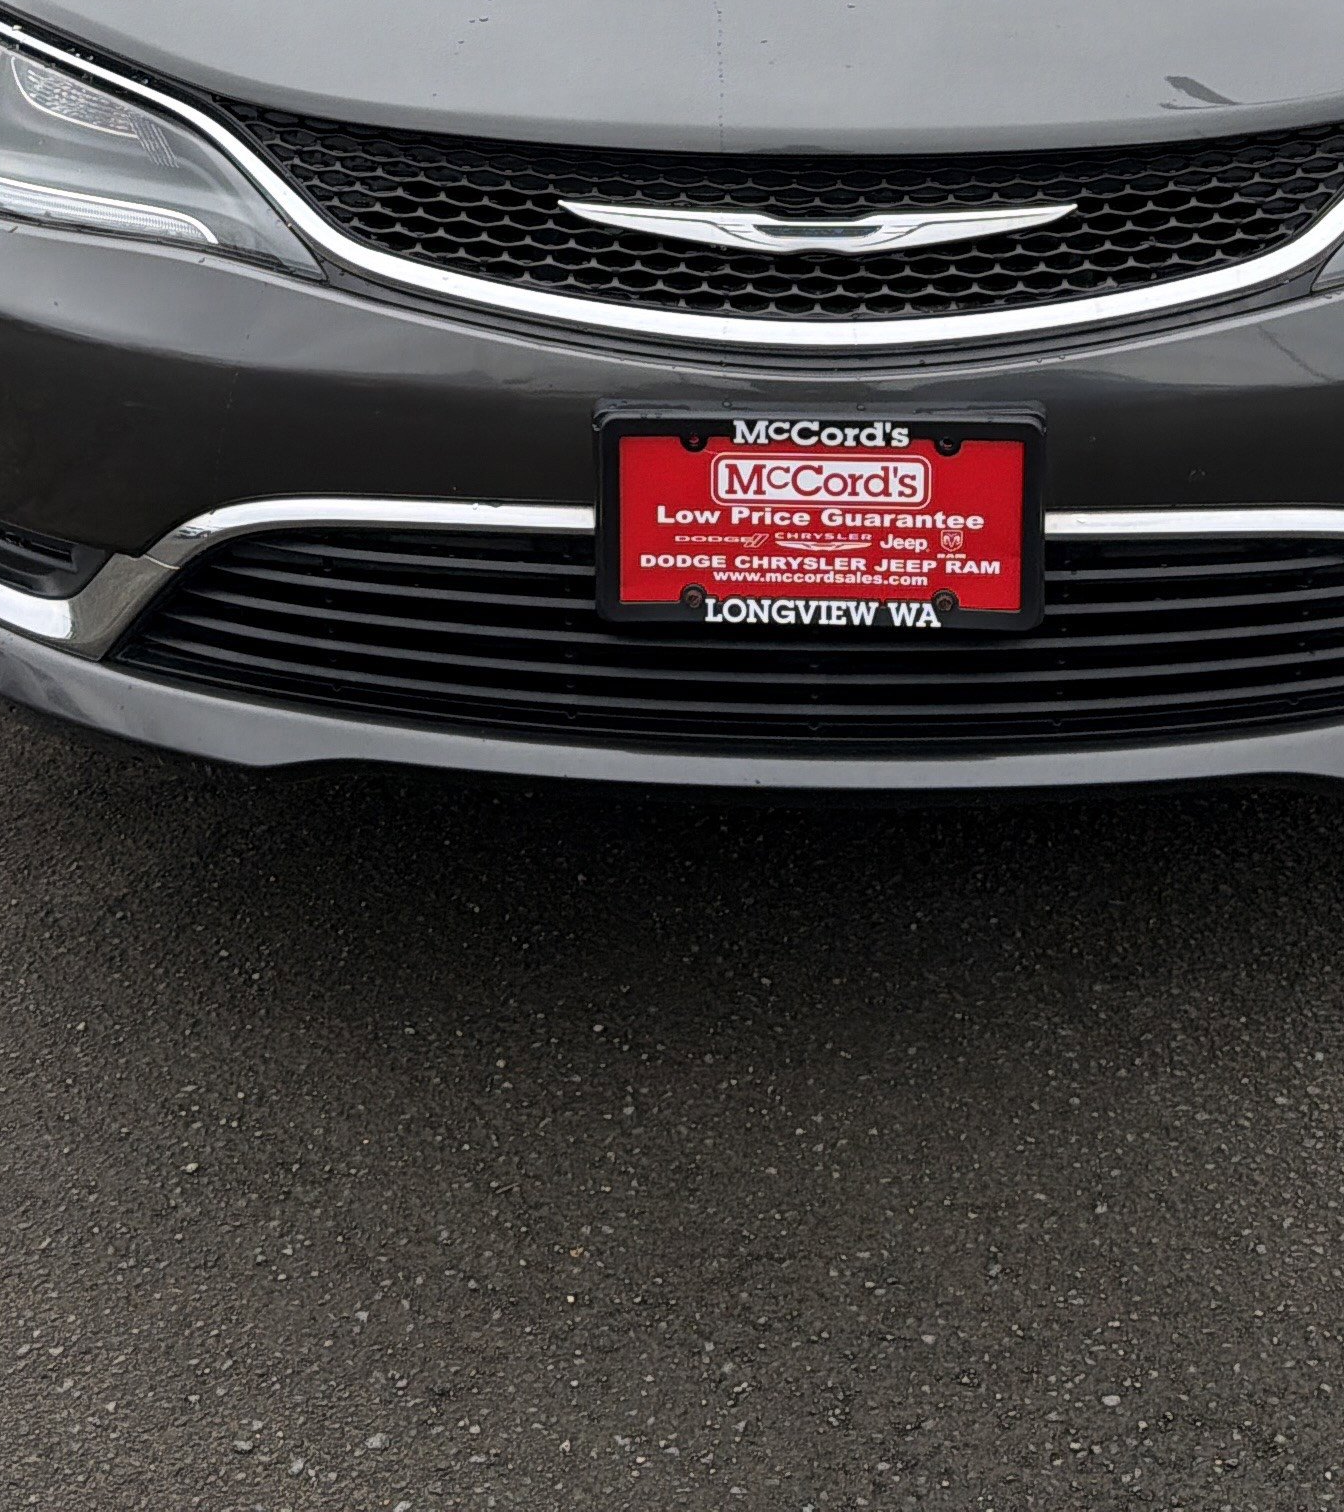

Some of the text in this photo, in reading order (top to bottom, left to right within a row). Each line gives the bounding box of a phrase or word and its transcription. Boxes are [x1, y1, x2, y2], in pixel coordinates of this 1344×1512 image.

[733, 420, 909, 448] McCord's
[725, 464, 918, 498] McCord's
[657, 505, 984, 530] Low Price Guarantee
[674, 535, 753, 543] DODGE
[774, 532, 873, 541] CHRYSLER
[880, 534, 928, 553] Jeep
[640, 555, 1001, 575] DODGE CHRYSLER JEEP RAM
[713, 571, 928, 586] www.mccordsales.com
[705, 598, 942, 628] LONGVIEW WA
